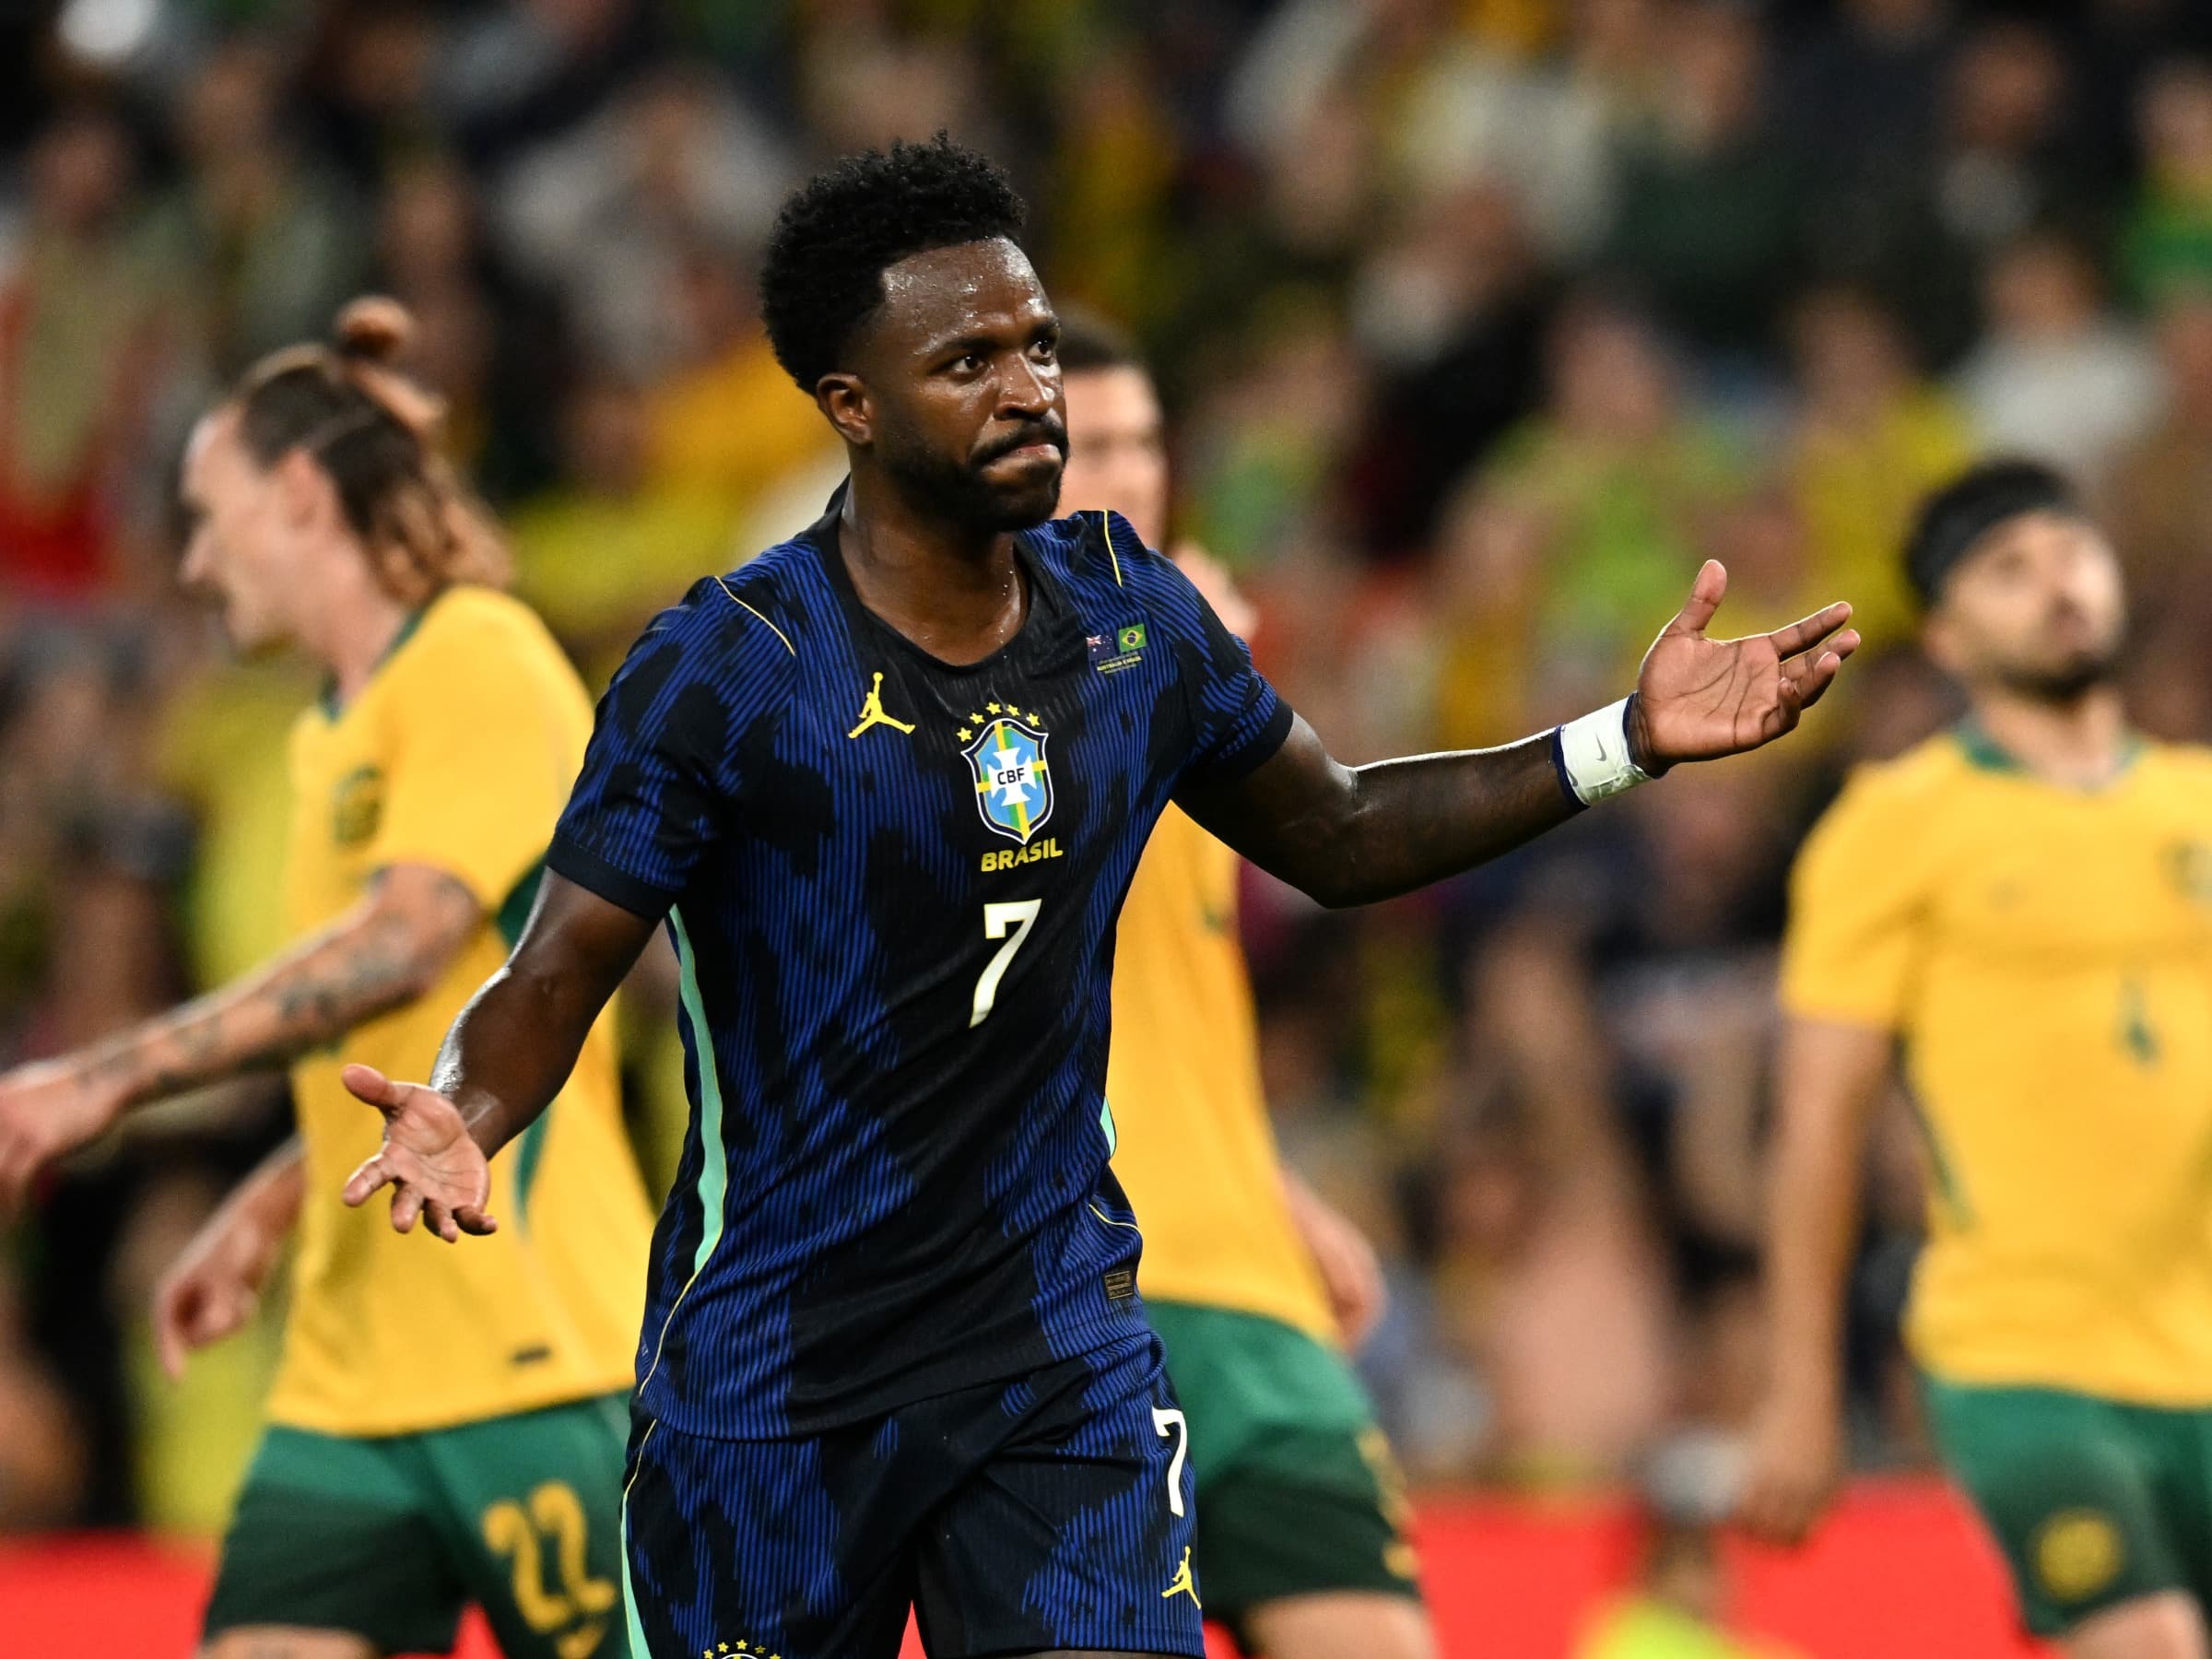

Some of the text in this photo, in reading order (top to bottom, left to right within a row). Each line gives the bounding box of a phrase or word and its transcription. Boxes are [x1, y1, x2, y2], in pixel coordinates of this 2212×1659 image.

[997, 767, 1026, 785] CBF
[981, 838, 1064, 872] BRASIL
[969, 899, 1042, 1029] 7
[1152, 1405, 1188, 1518] 7
[482, 1480, 616, 1633] 22
